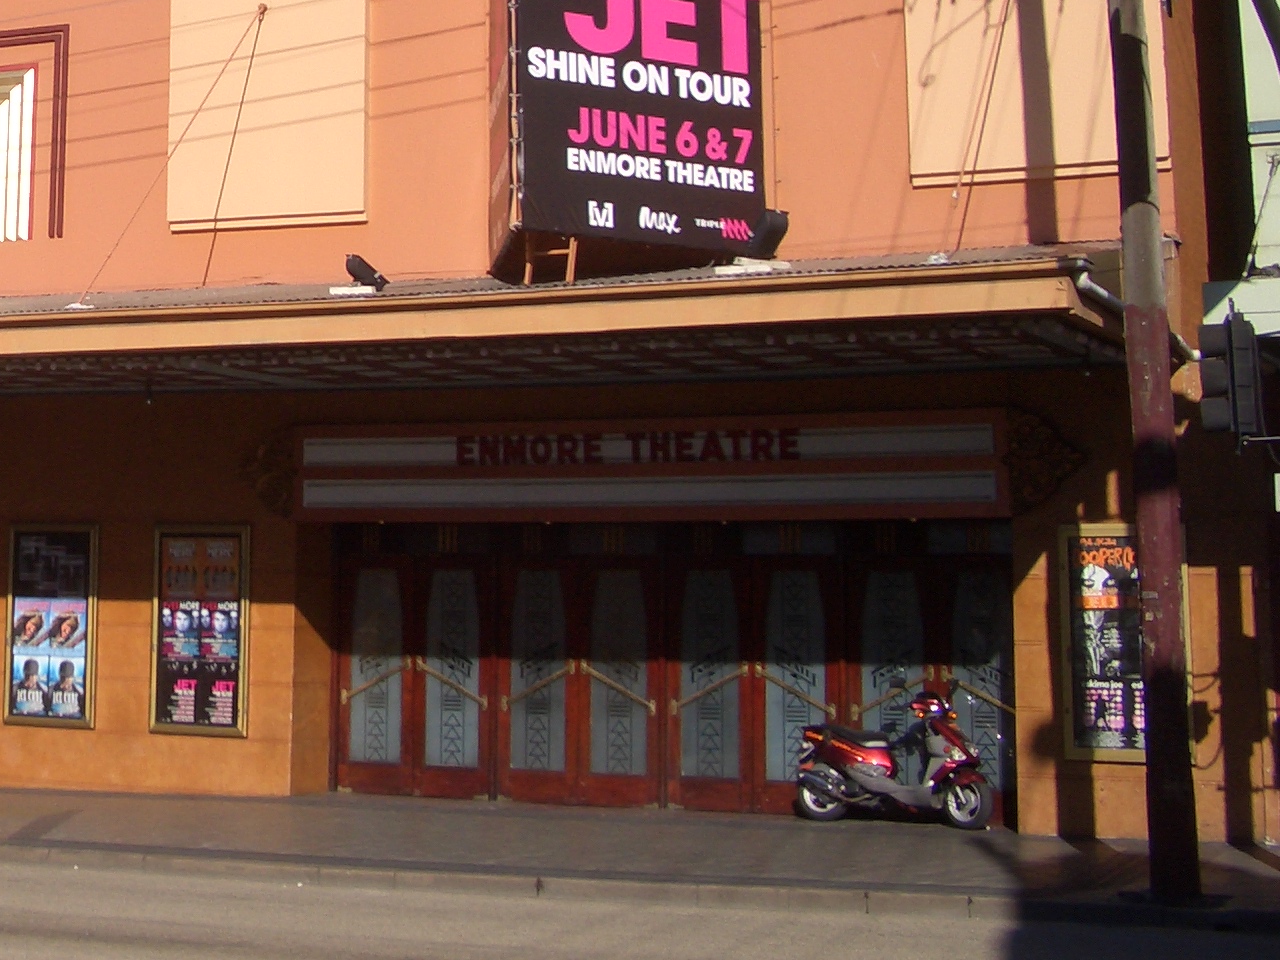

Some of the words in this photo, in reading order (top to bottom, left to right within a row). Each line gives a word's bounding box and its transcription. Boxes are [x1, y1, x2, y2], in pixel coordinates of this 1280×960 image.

[526, 46, 617, 89] SHINE
[622, 60, 670, 97] ON
[674, 67, 752, 109] TOUR
[567, 106, 667, 155] JUNE
[566, 146, 662, 182] ENMORE
[664, 159, 755, 193] THEATRE
[456, 434, 603, 466] ENMORE
[626, 428, 801, 464] THEATRE
[174, 679, 198, 691] JET
[212, 681, 235, 693] JET
